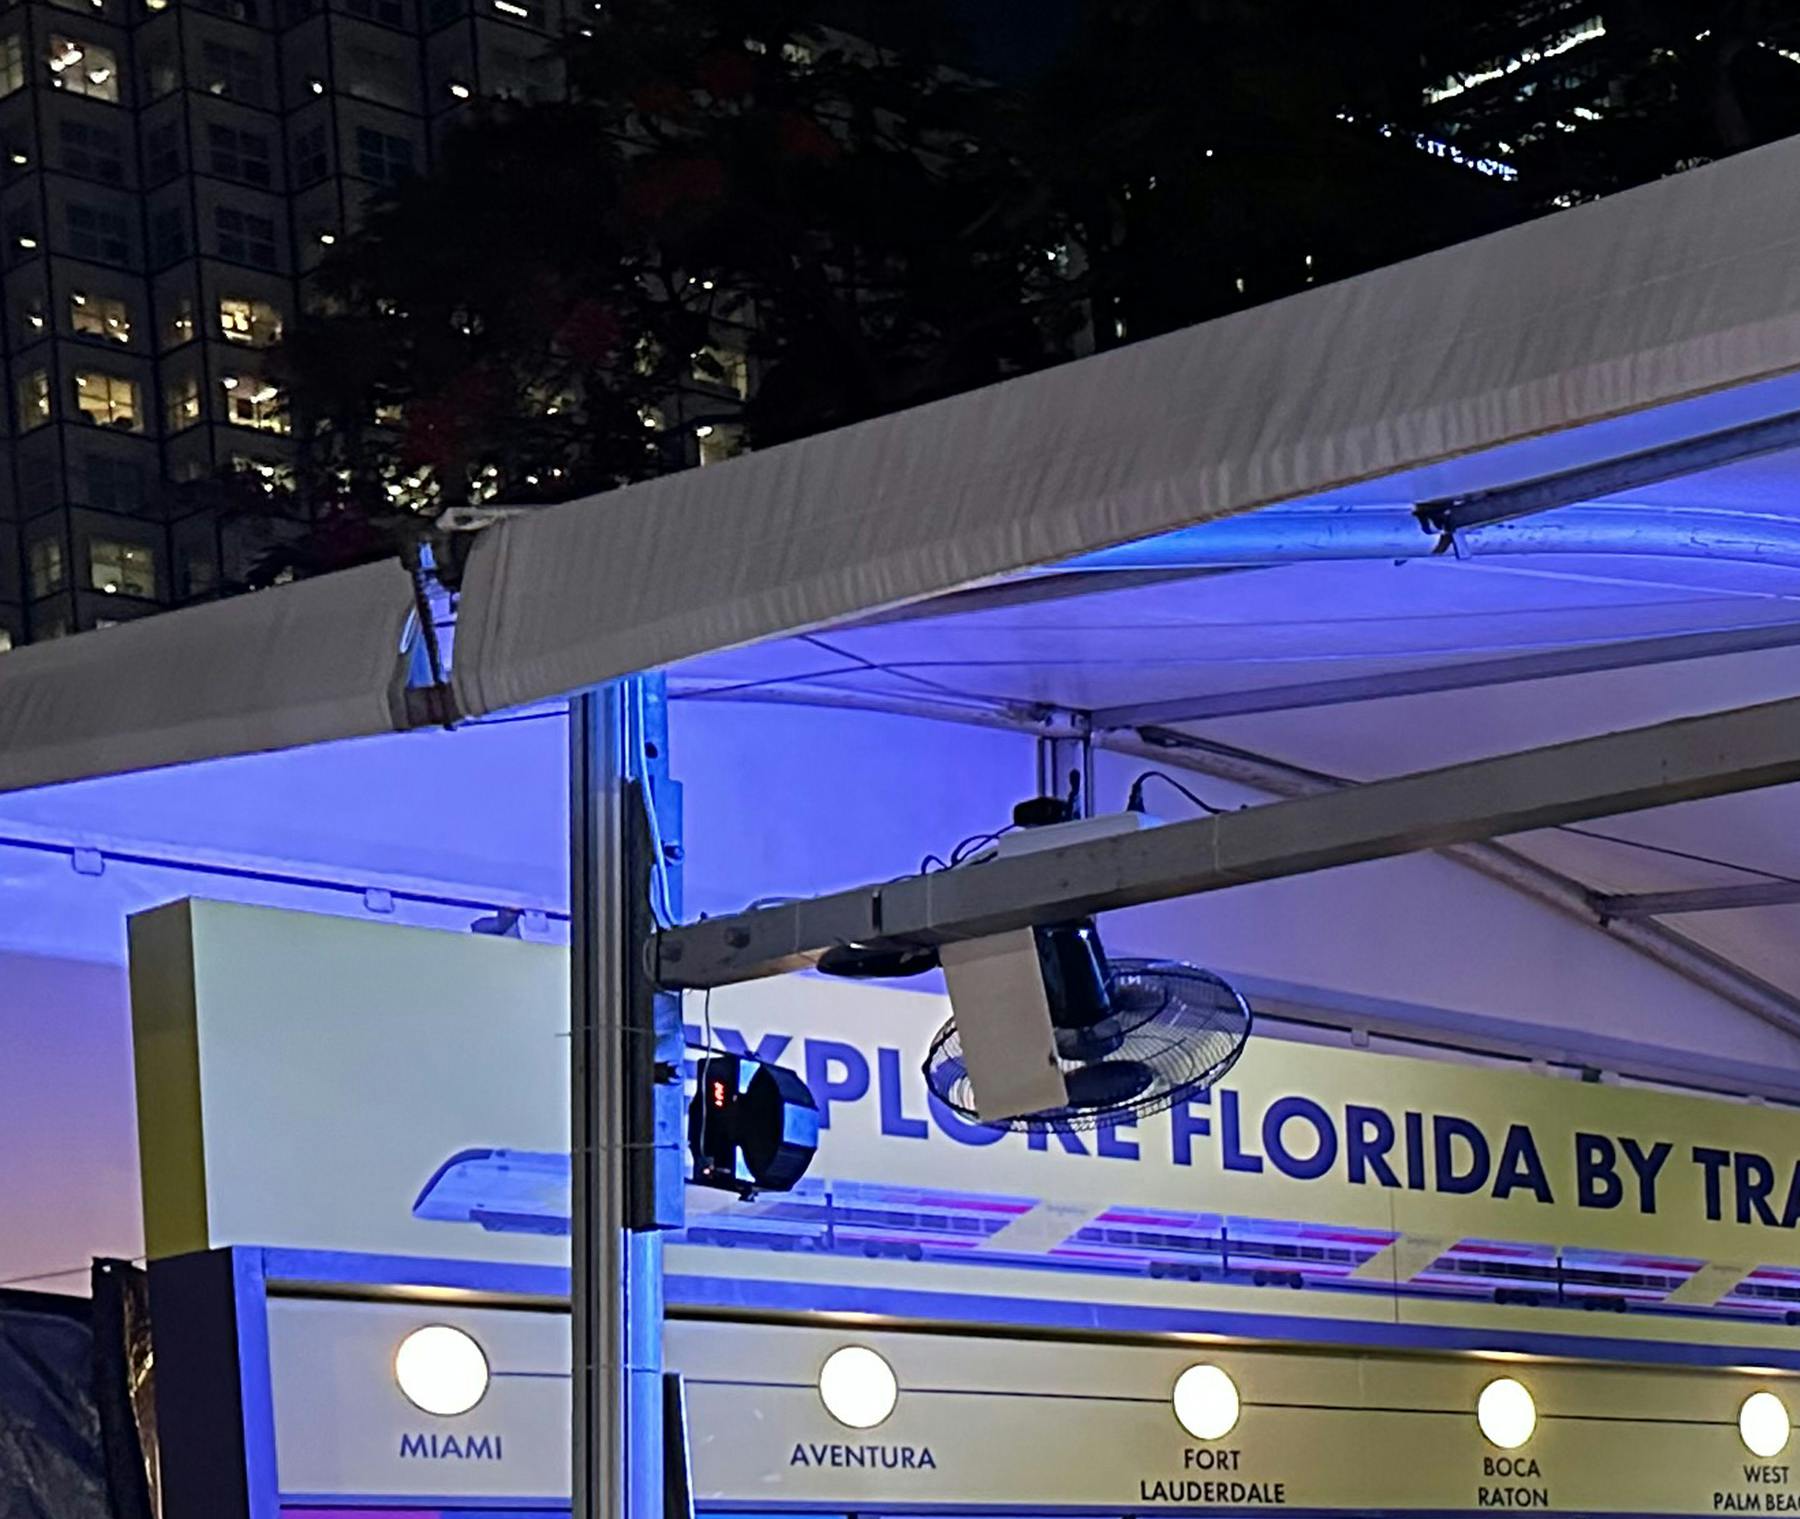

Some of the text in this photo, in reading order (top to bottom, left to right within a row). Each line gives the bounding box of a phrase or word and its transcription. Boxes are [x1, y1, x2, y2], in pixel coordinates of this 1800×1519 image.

[1171, 1085, 1554, 1204] FLORIDA
[1574, 1131, 1674, 1215] BY
[399, 1432, 503, 1461] MIAMI
[789, 1442, 937, 1470] AVENTURA
[1183, 1448, 1241, 1471] FORT
[1483, 1457, 1541, 1478] BOCA
[1743, 1464, 1790, 1485] WEST
[1140, 1480, 1286, 1504] LAUDERDALE
[1478, 1487, 1549, 1508] RATON
[1713, 1492, 1761, 1512] PALM
